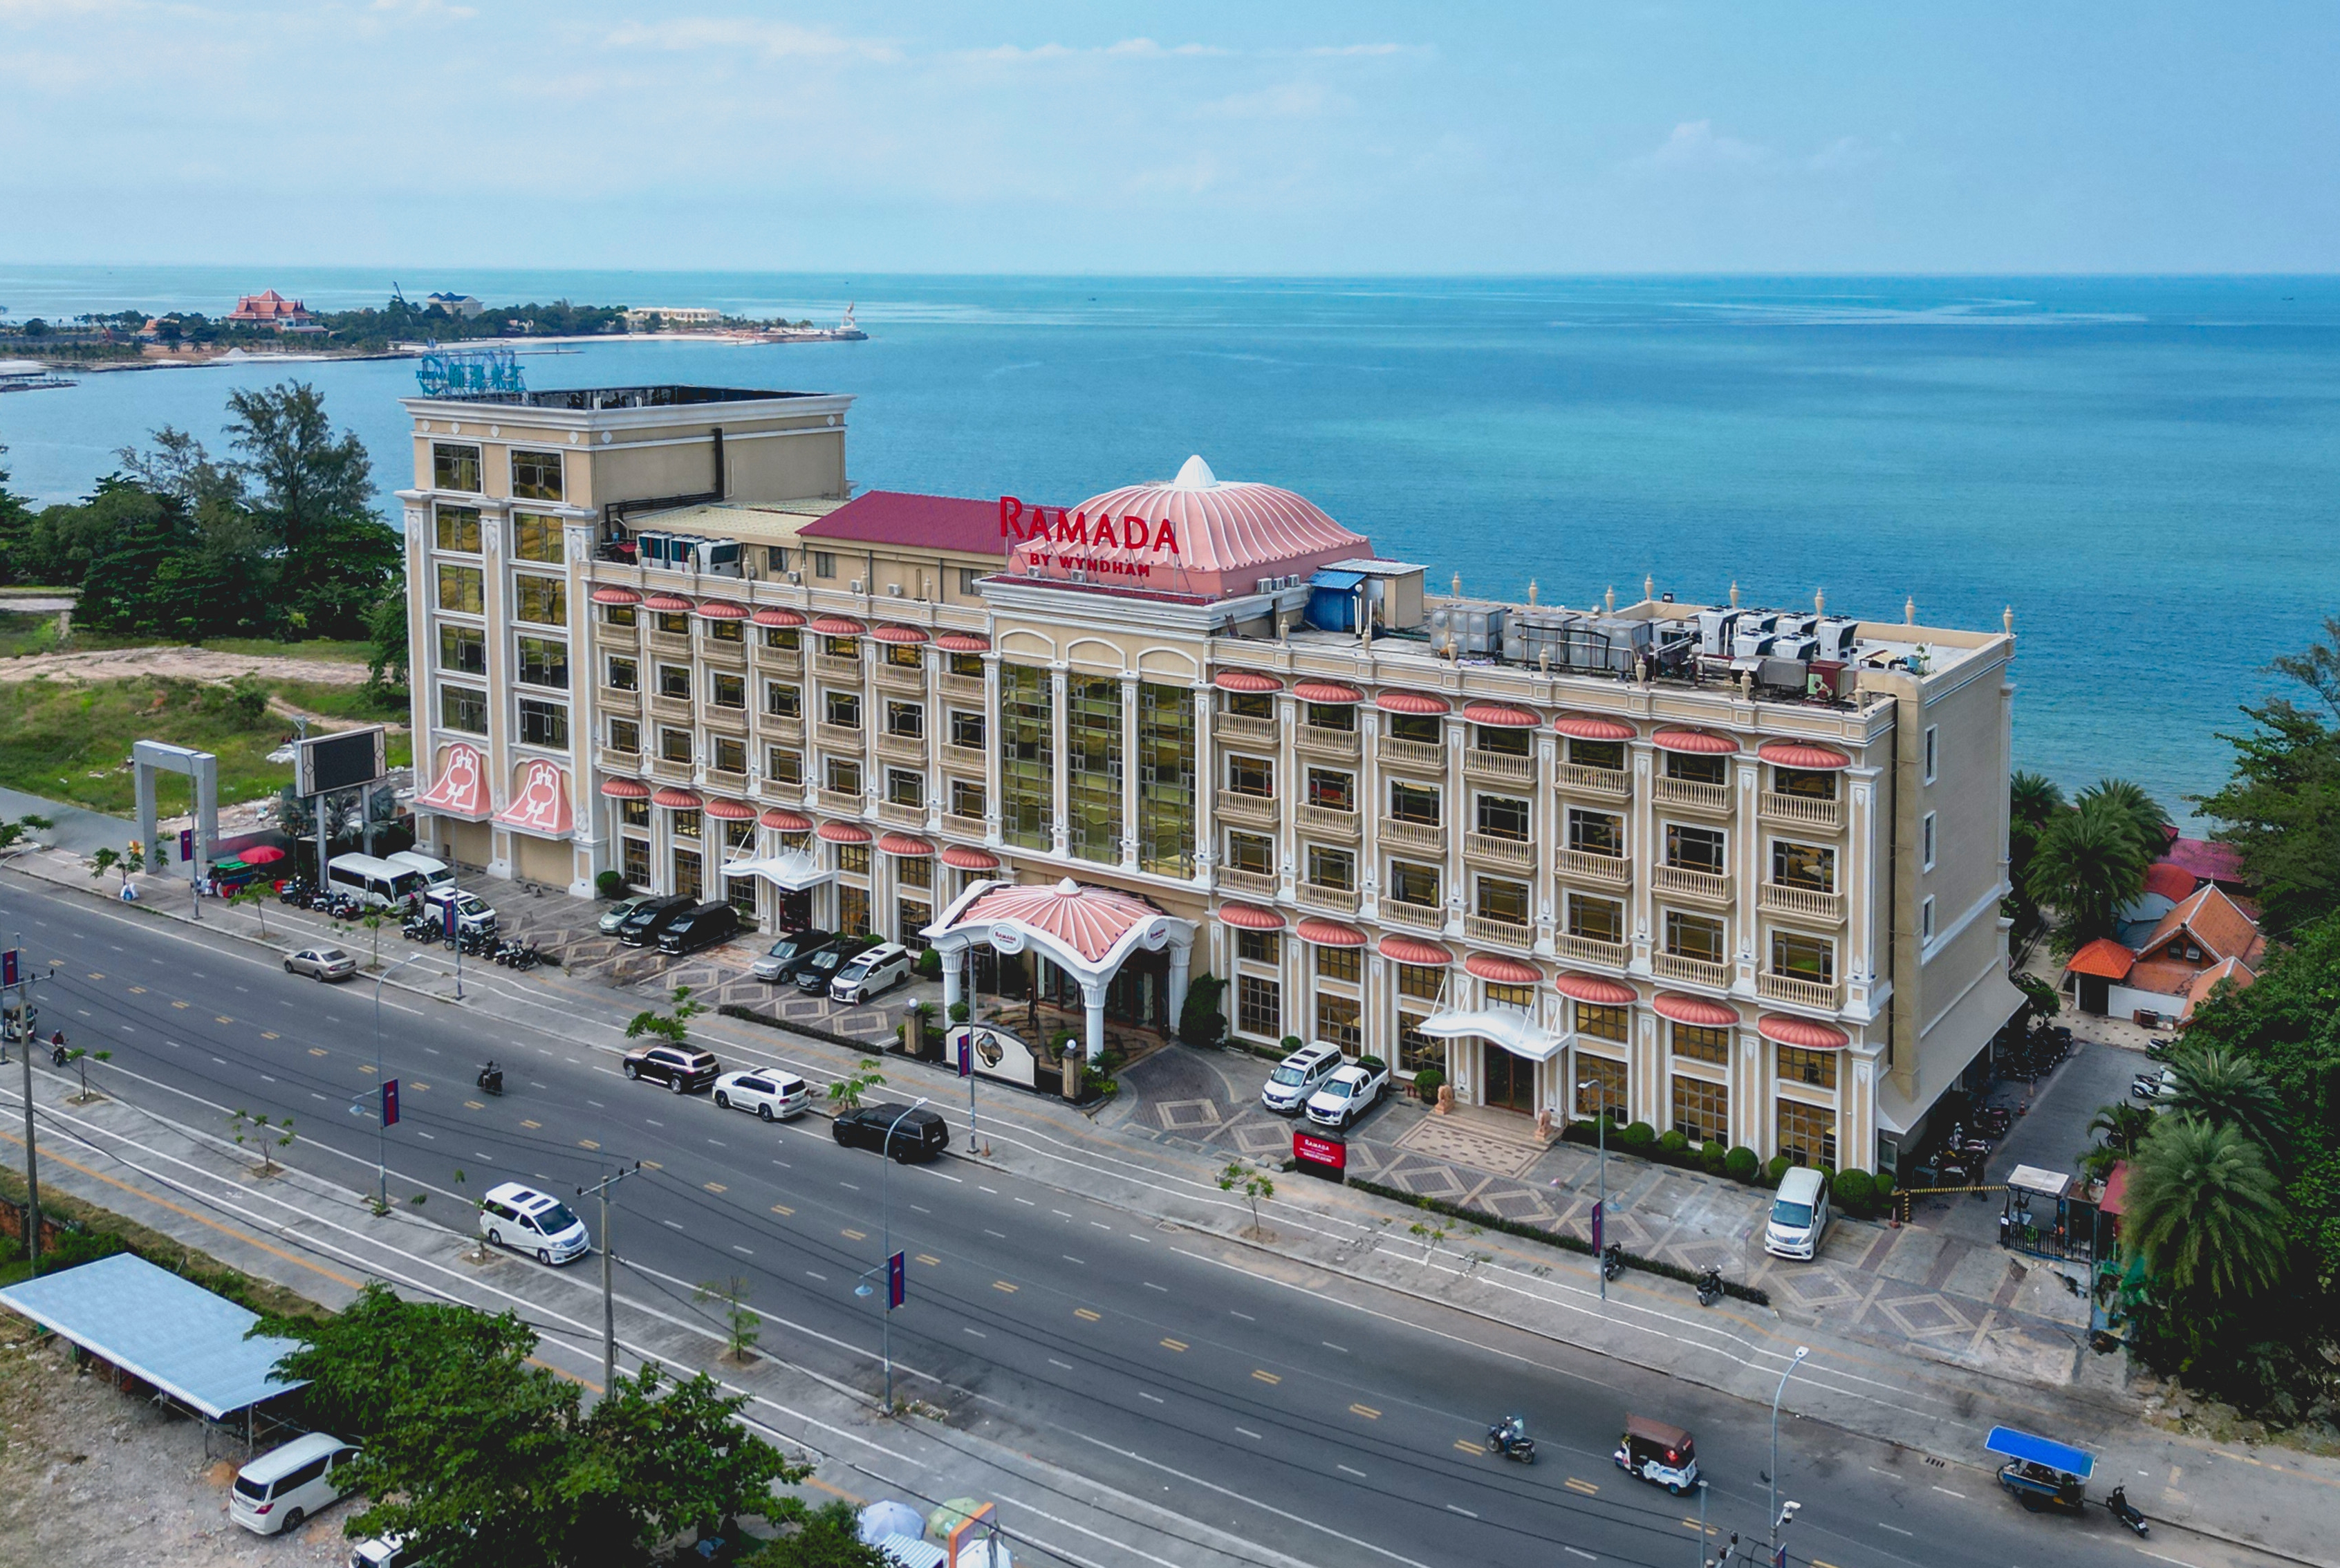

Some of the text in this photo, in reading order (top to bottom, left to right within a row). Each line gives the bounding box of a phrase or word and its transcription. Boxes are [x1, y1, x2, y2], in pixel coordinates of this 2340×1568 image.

[1000, 496, 1180, 554] RAMADA
[1030, 552, 1150, 577] BY WYNDHAM
[1304, 1139, 1330, 1151] RAMADA
